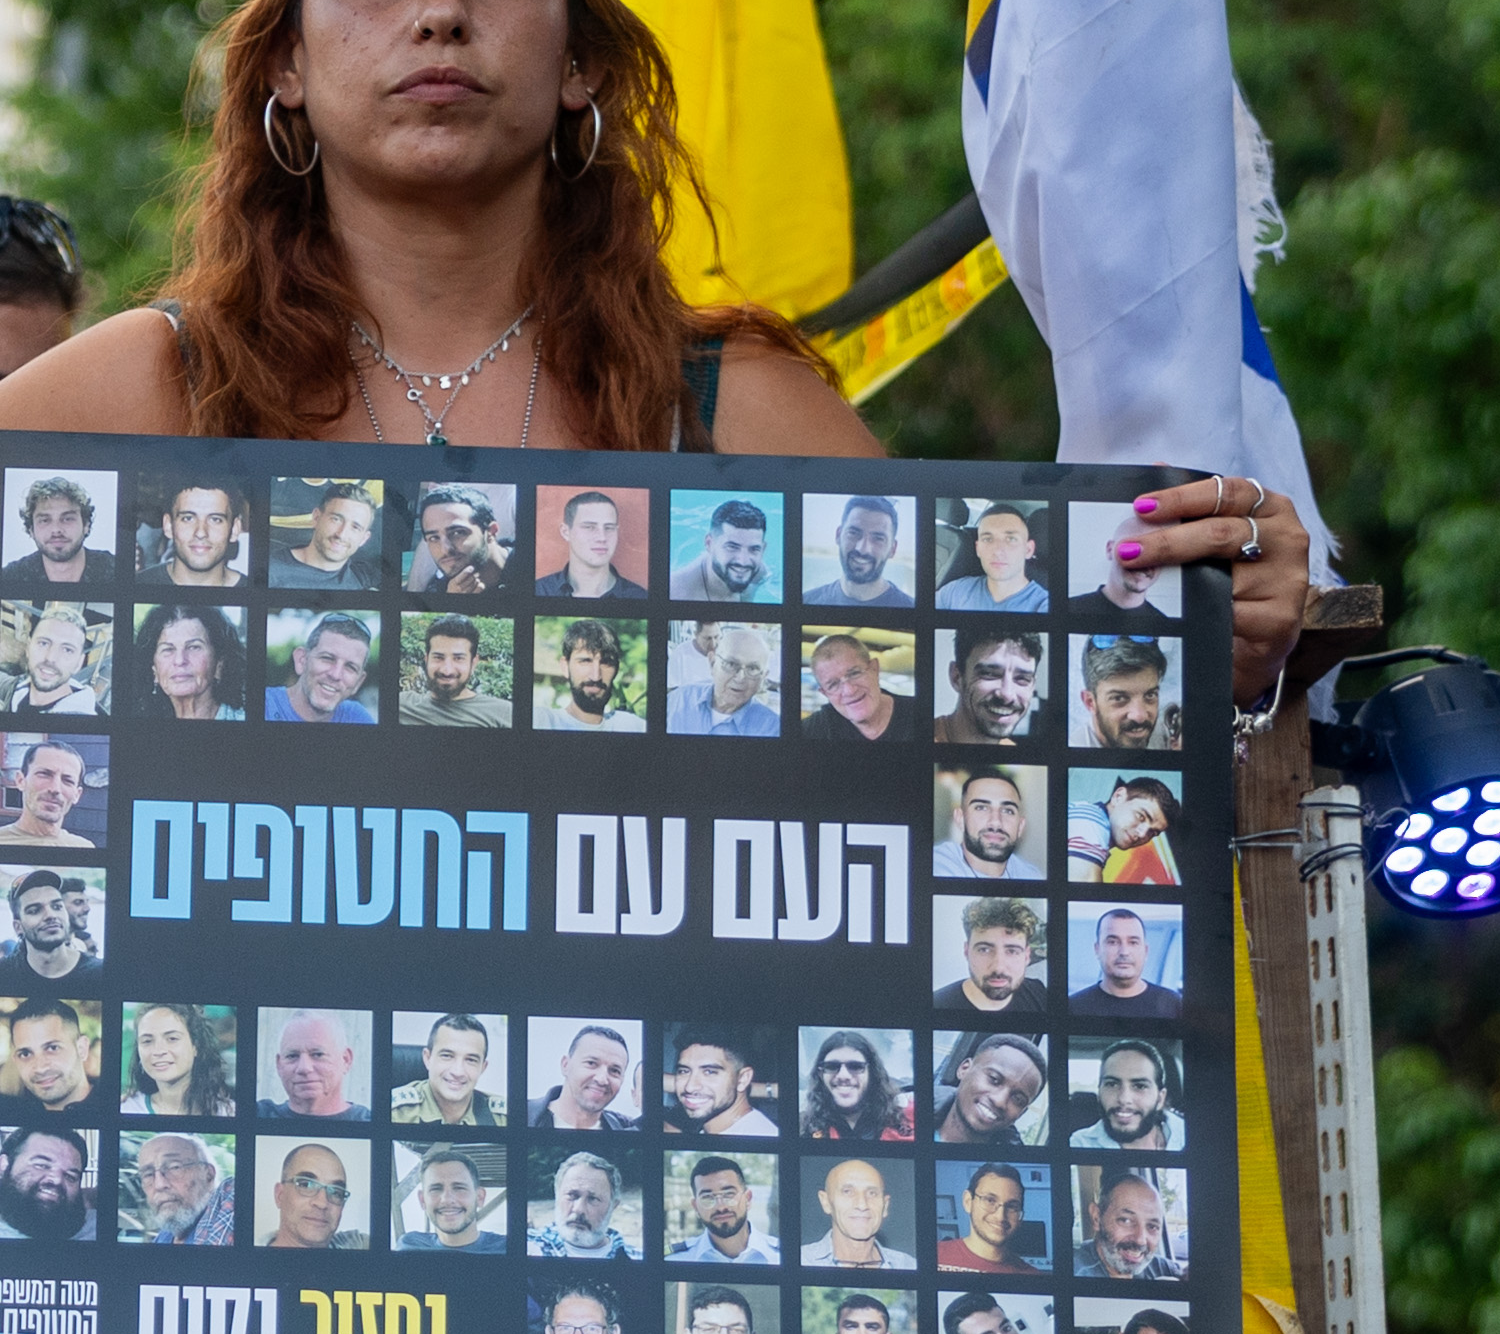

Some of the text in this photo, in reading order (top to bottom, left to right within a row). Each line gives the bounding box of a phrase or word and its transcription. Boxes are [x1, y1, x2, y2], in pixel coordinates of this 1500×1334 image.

[129, 799, 910, 945] העם עם החטופים
[60, 1280, 98, 1306] מטה
